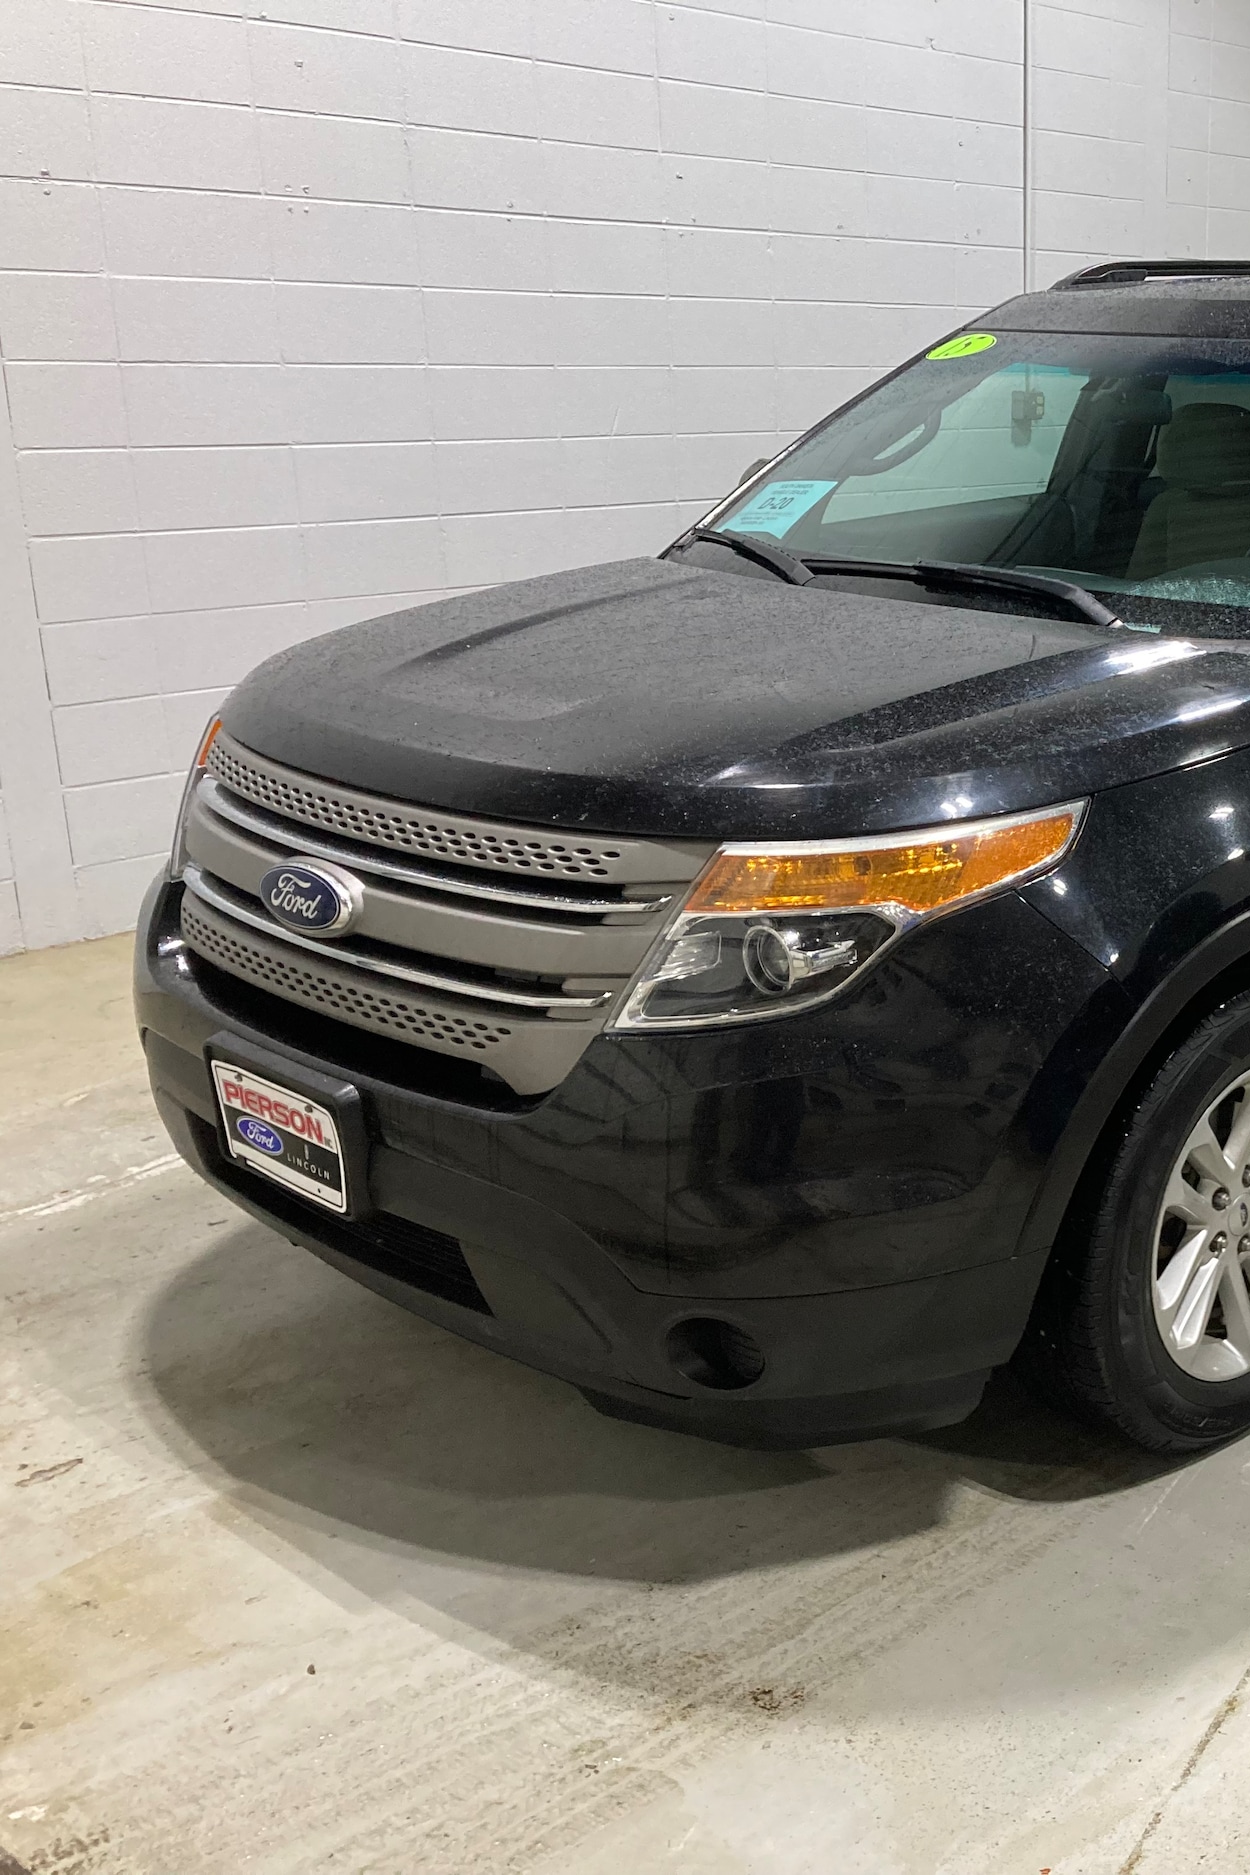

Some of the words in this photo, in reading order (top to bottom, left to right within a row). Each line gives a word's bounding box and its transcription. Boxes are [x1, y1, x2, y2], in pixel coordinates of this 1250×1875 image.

[757, 497, 795, 509] D-20
[270, 873, 322, 919] Ford
[223, 1081, 325, 1144] PIERSON
[246, 1121, 275, 1150] Ford
[286, 1152, 331, 1180] LINCOLN
